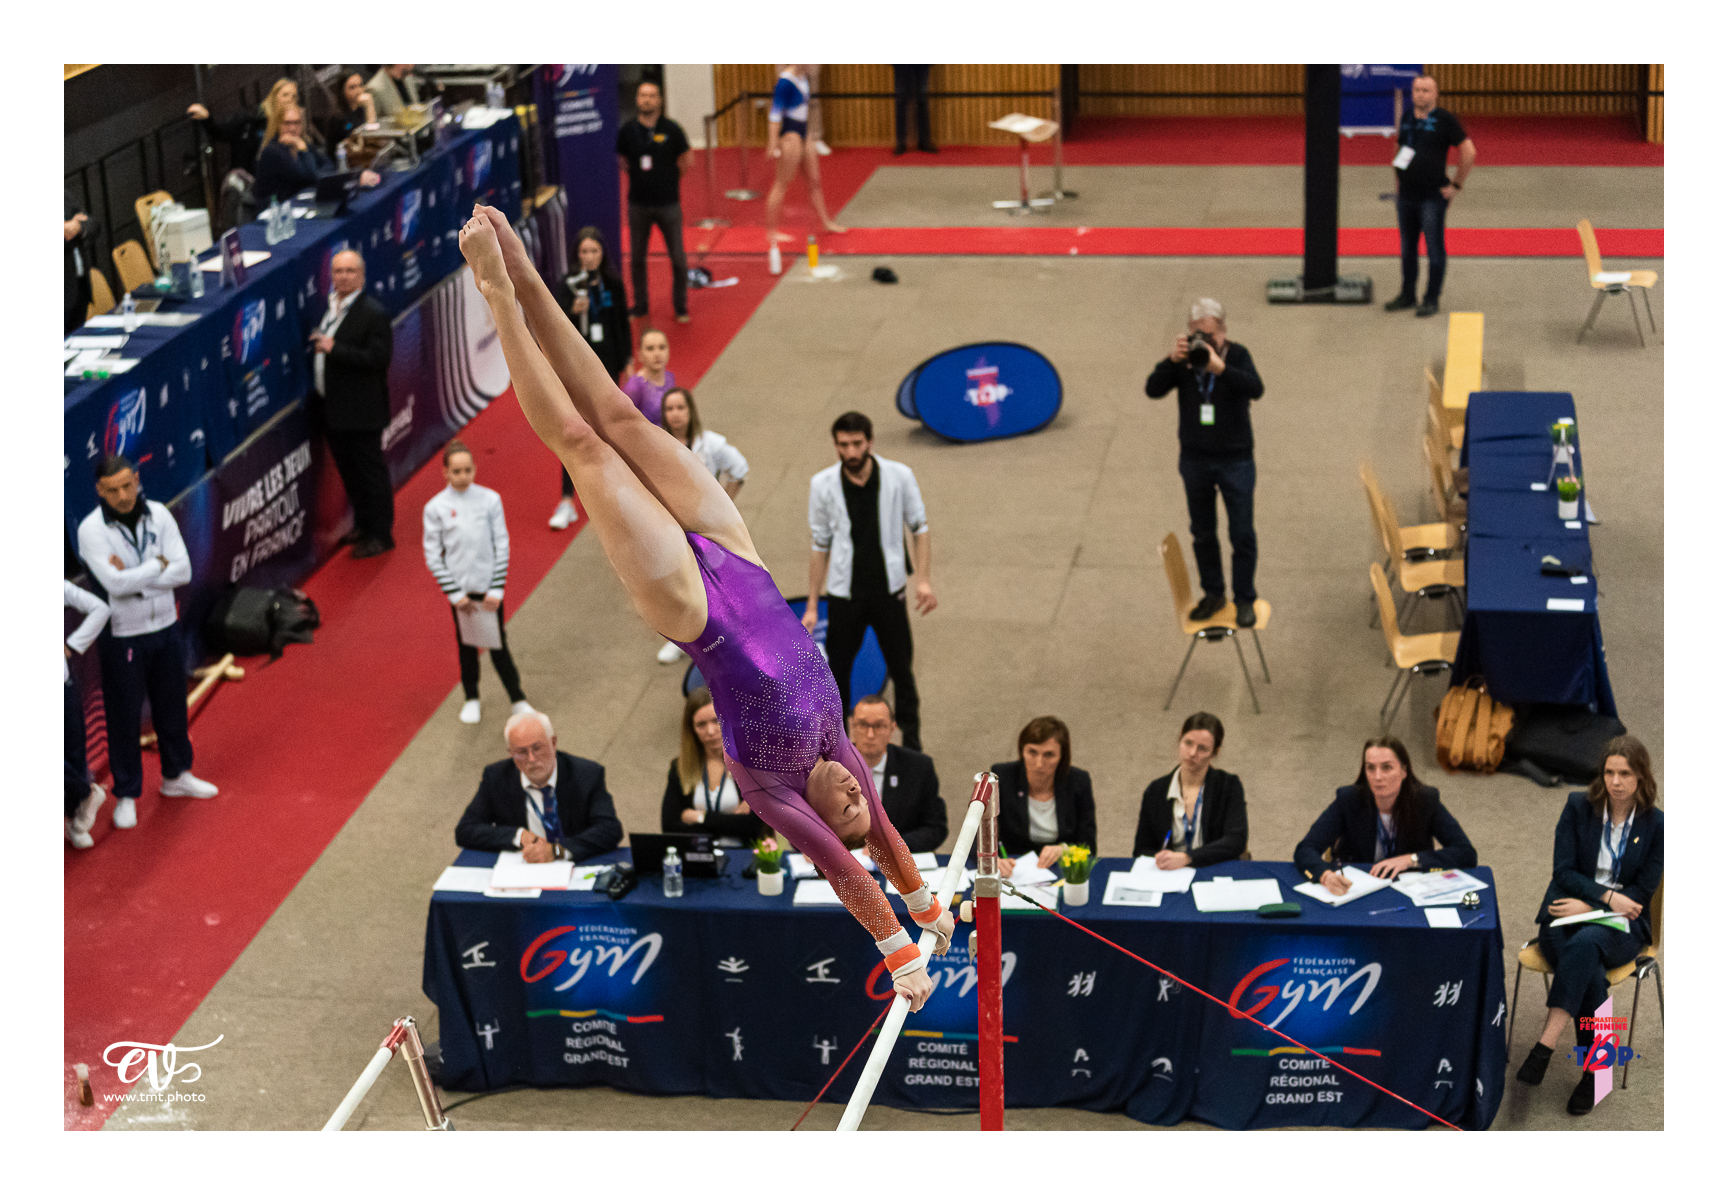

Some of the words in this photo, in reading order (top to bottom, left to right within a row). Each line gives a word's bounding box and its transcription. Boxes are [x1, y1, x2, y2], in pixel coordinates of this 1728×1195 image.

[702, 635, 725, 653] Quatro
[1293, 957, 1356, 966] FÉDÉRATION
[1293, 967, 1348, 977] FRANÇAISE
[917, 1041, 968, 1055] COMITÉ
[563, 1050, 607, 1064] GRAND
[608, 1053, 630, 1068] EST
[908, 1056, 977, 1072] RÉGIONAL
[904, 1074, 953, 1086] GRAND
[955, 1075, 980, 1087] EST
[1269, 1073, 1340, 1087] RÉGIONAL
[1265, 1092, 1315, 1105] GRAND
[1317, 1091, 1344, 1103] EST
